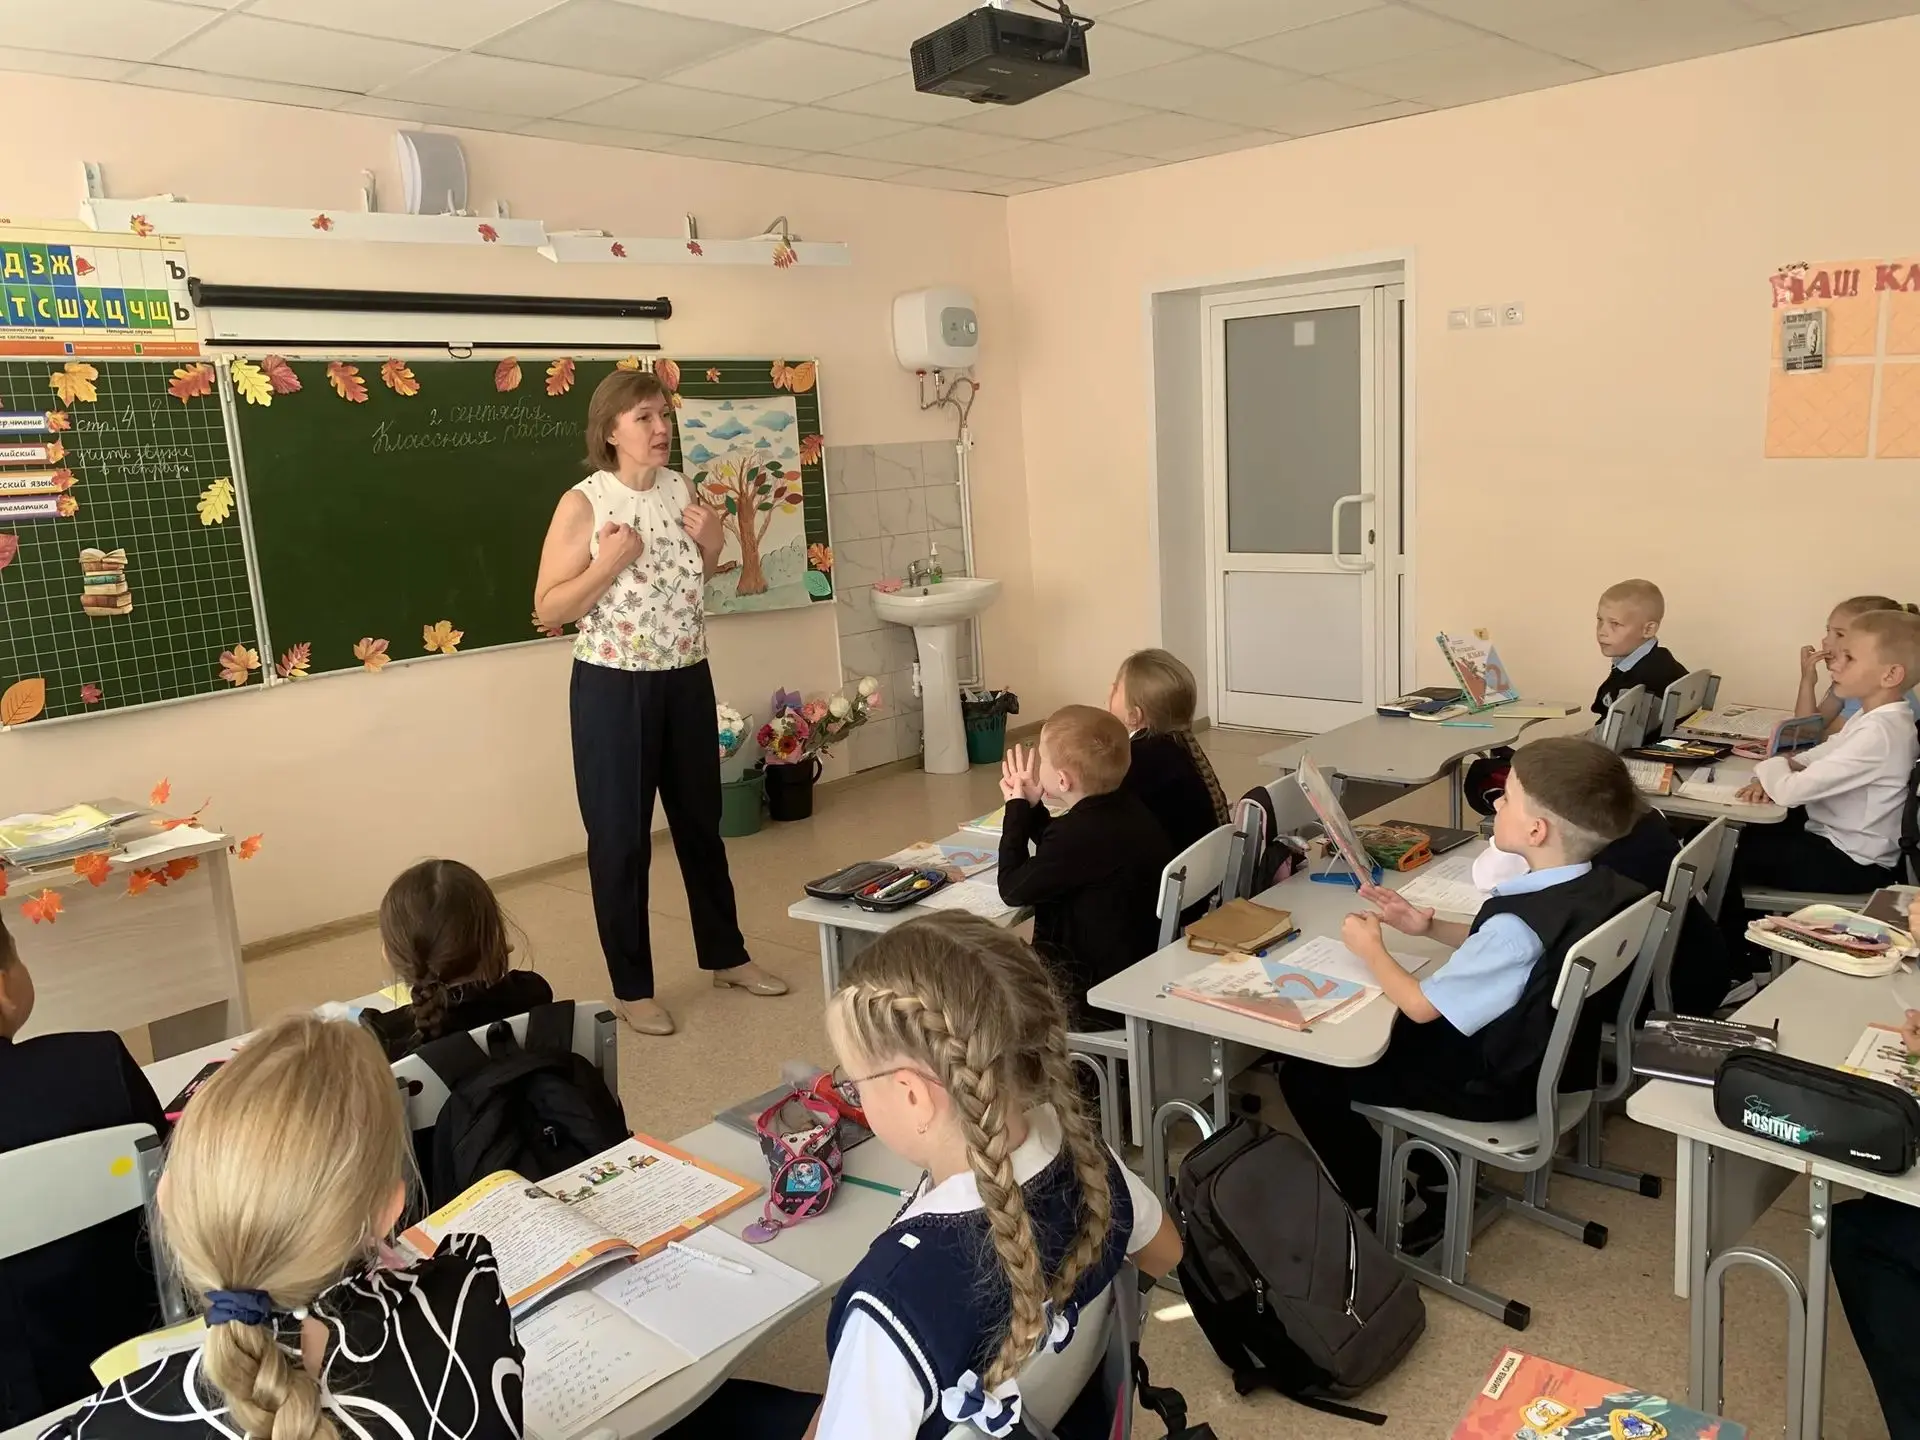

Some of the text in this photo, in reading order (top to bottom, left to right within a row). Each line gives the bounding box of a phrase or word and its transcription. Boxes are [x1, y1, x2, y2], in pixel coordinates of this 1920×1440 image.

[4, 252, 186, 279] Д З Ж Ъ
[11, 297, 191, 324] Т С Ш Х Ц Ч Щ Ь
[121, 403, 135, 432] 4
[429, 408, 443, 426] 2
[372, 420, 497, 454] Классная
[30, 480, 55, 488] язык
[1273, 973, 1339, 998] 2
[1743, 1109, 1801, 1143] POSITIVE
